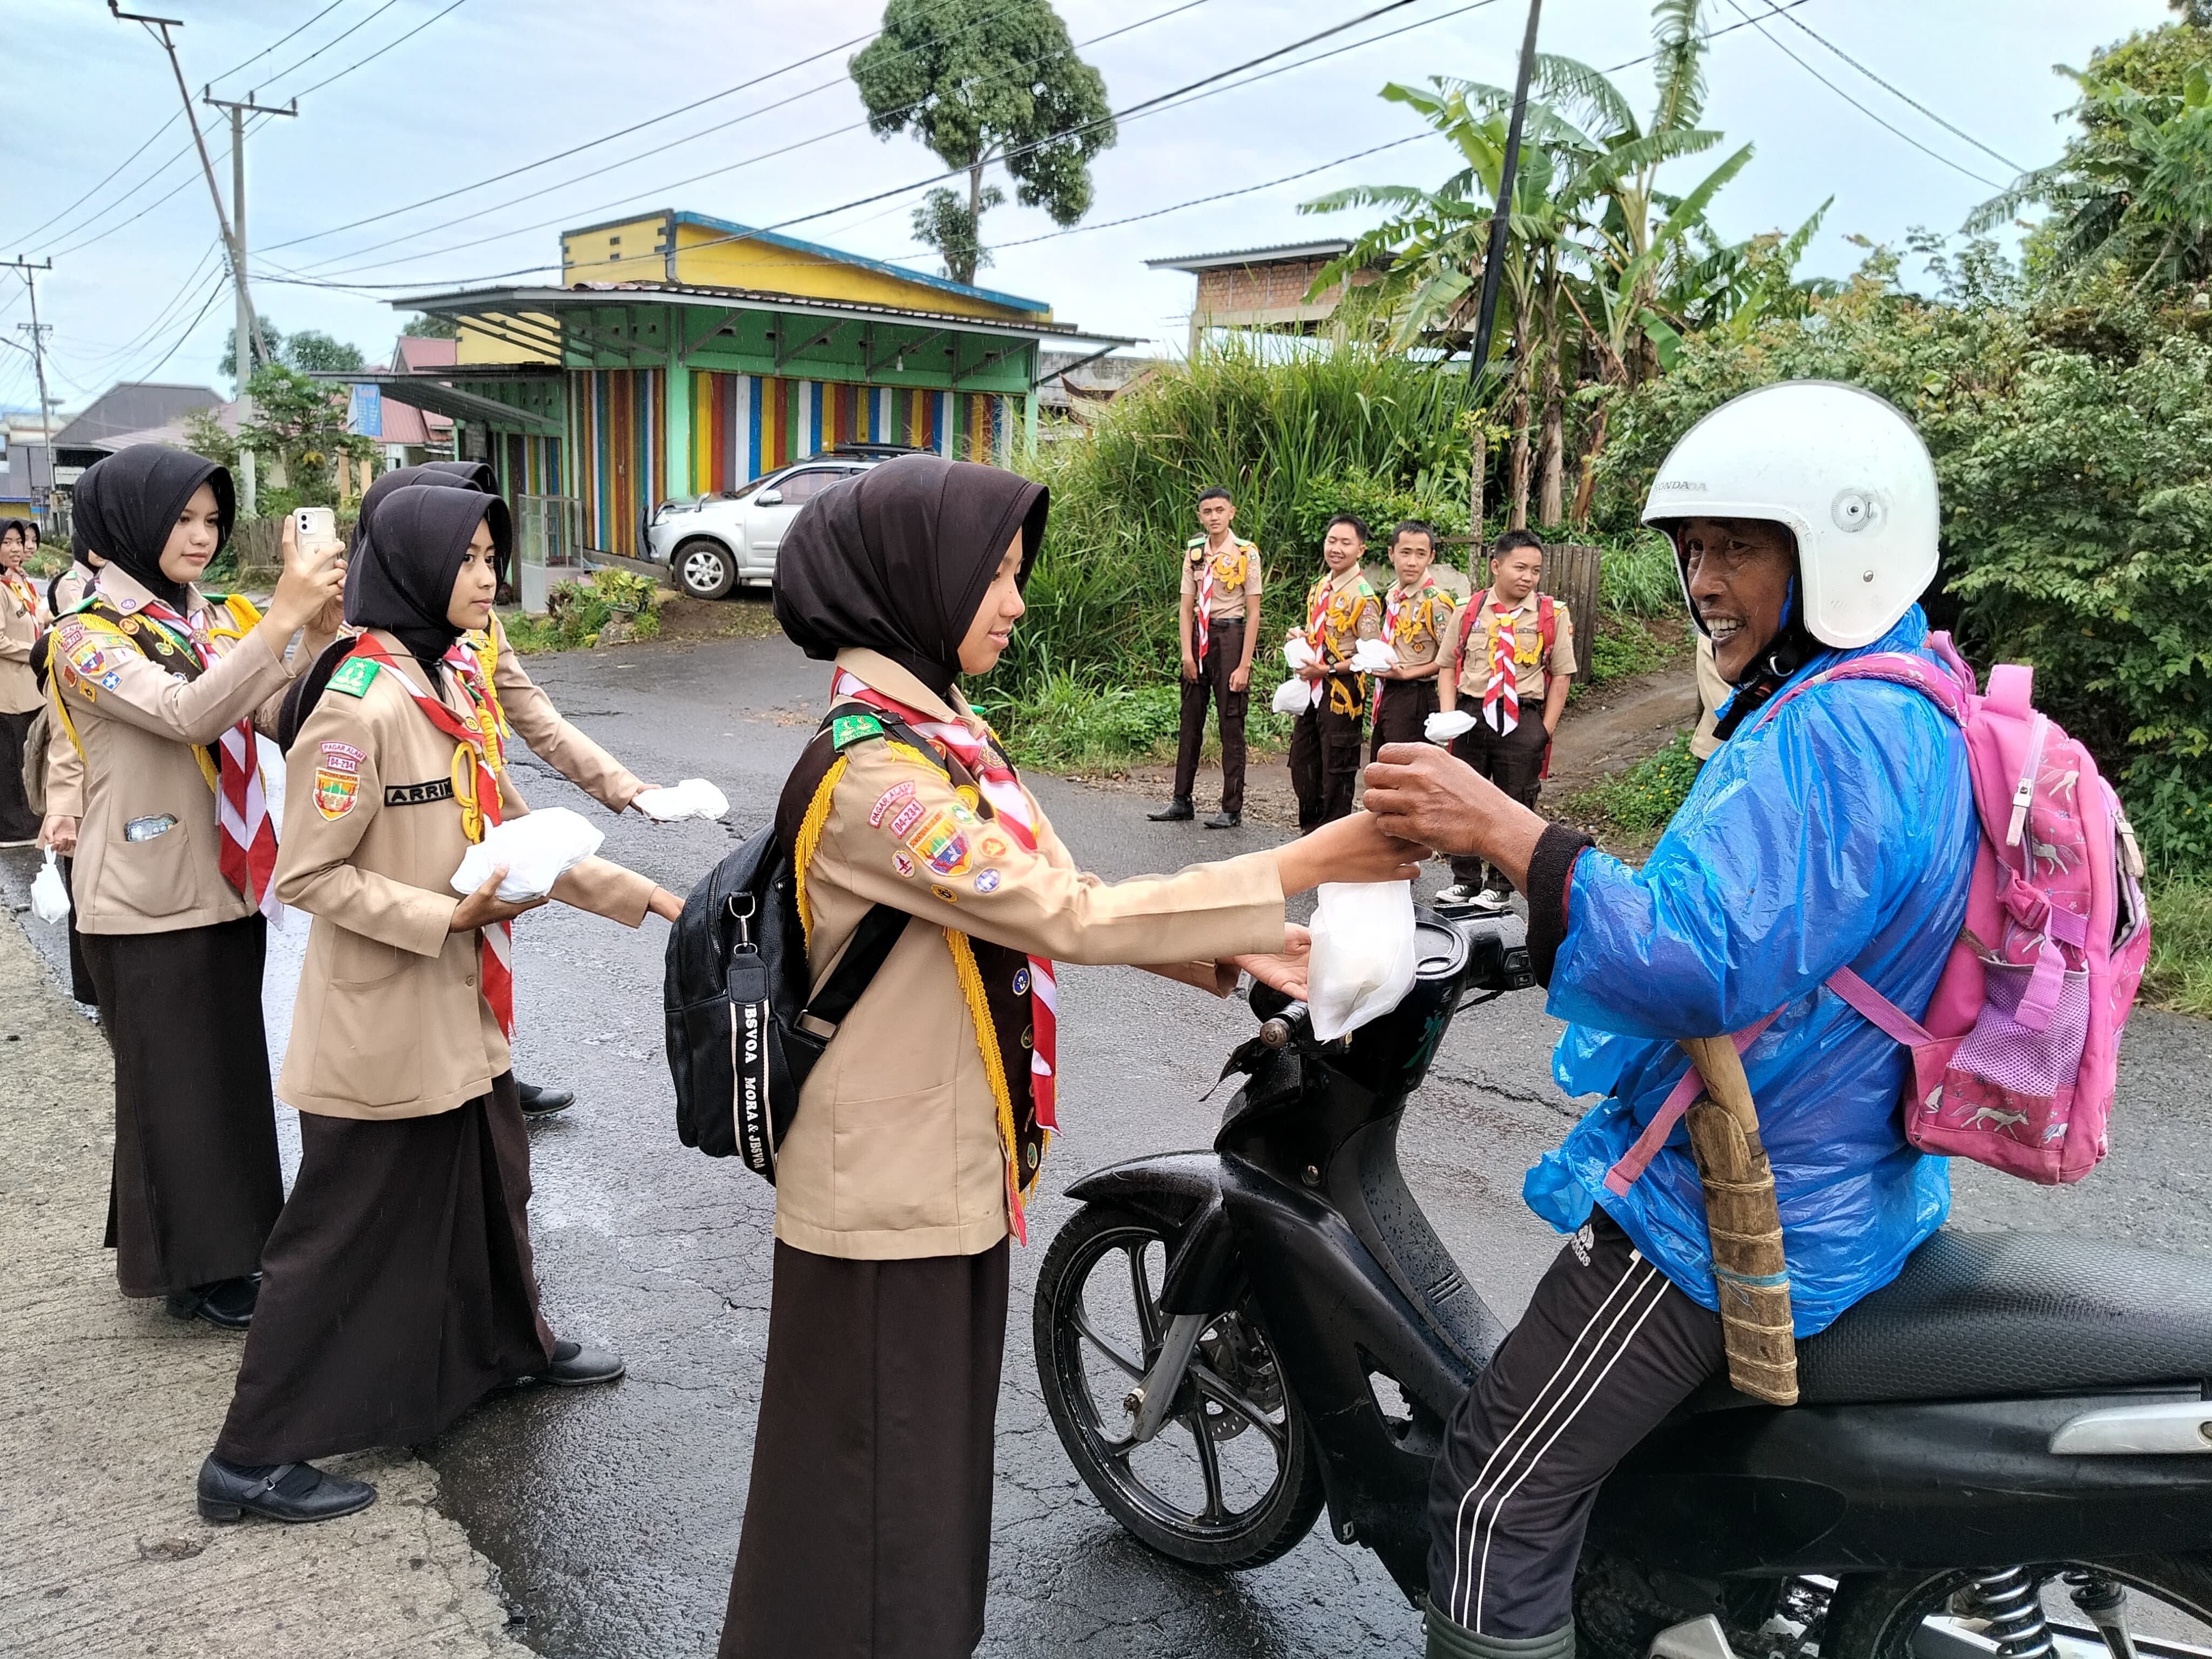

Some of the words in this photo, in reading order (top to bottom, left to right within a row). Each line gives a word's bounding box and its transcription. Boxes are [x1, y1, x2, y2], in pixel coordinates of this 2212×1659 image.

[1654, 481, 1690, 492] HONDA
[346, 748, 364, 759] ALAM
[872, 798, 889, 823] PAGAR
[894, 804, 921, 832] 04-234
[744, 1077, 759, 1122] MORA
[747, 1123, 759, 1133] &
[748, 1135, 766, 1169] JBSVOA
